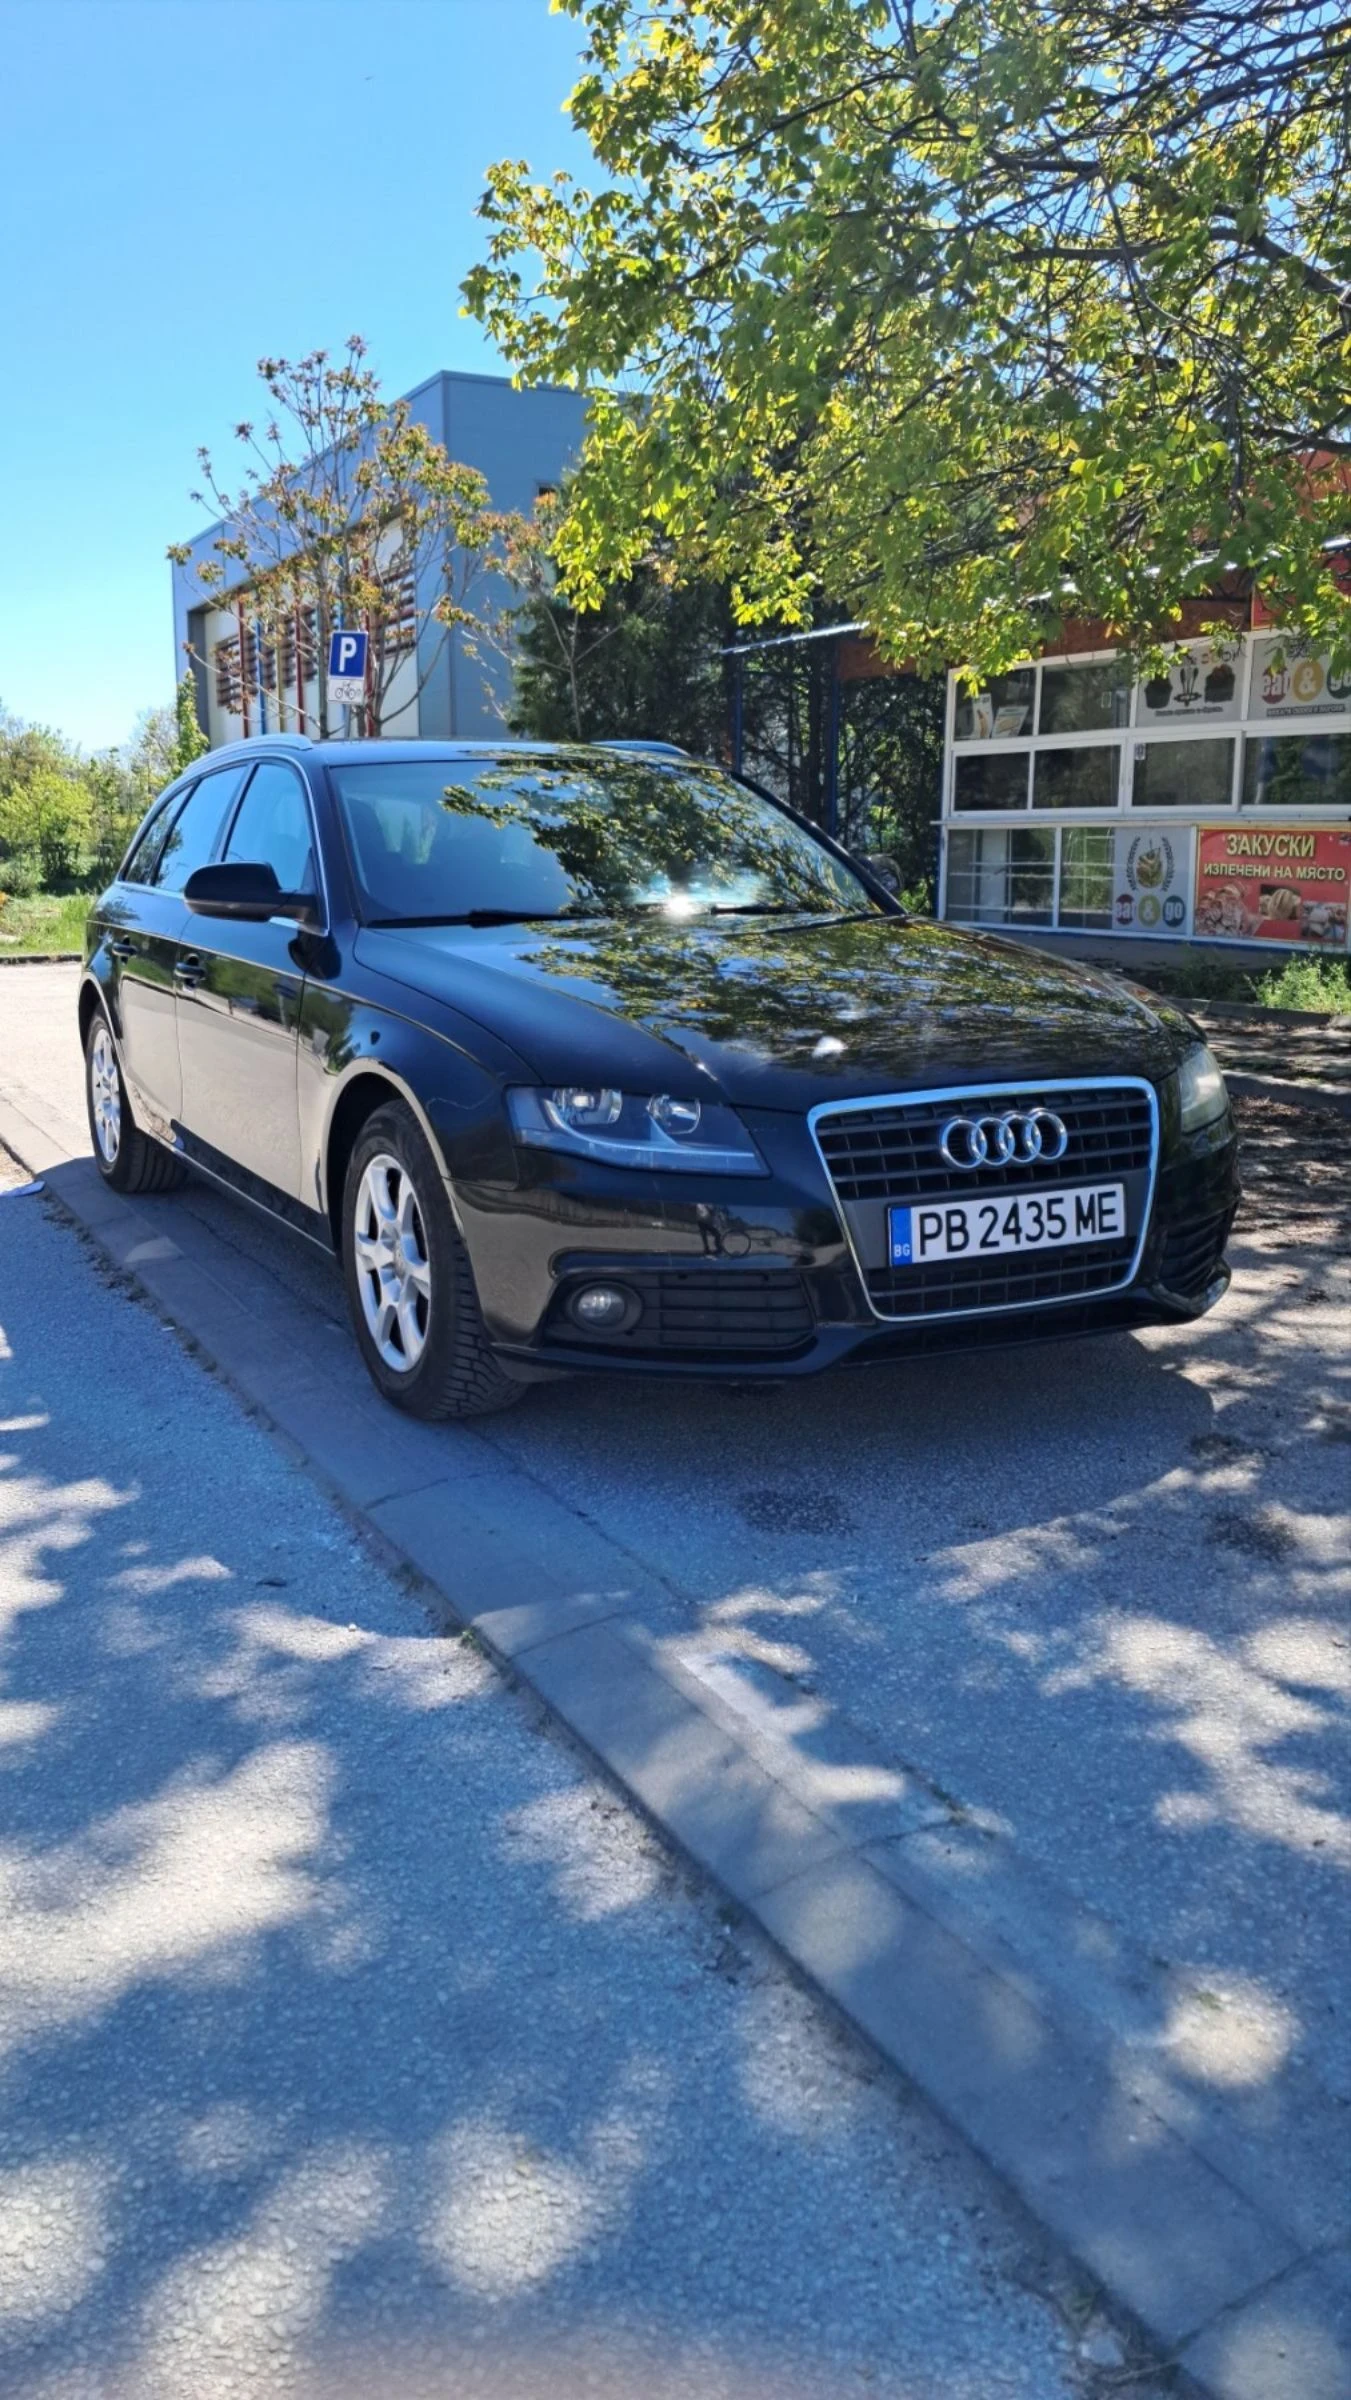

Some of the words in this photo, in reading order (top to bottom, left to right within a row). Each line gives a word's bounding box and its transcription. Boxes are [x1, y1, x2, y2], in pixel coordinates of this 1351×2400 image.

[339, 637, 357, 673] P
[1226, 834, 1316, 858] ЗАКУСКИ
[1274, 866, 1293, 878] НА
[1297, 866, 1346, 881] МЯСТО
[1165, 901, 1183, 922] go
[893, 1244, 911, 1257] BG
[919, 1208, 970, 1256] PB
[978, 1197, 1067, 1249] 2435
[1075, 1190, 1119, 1237] ME
